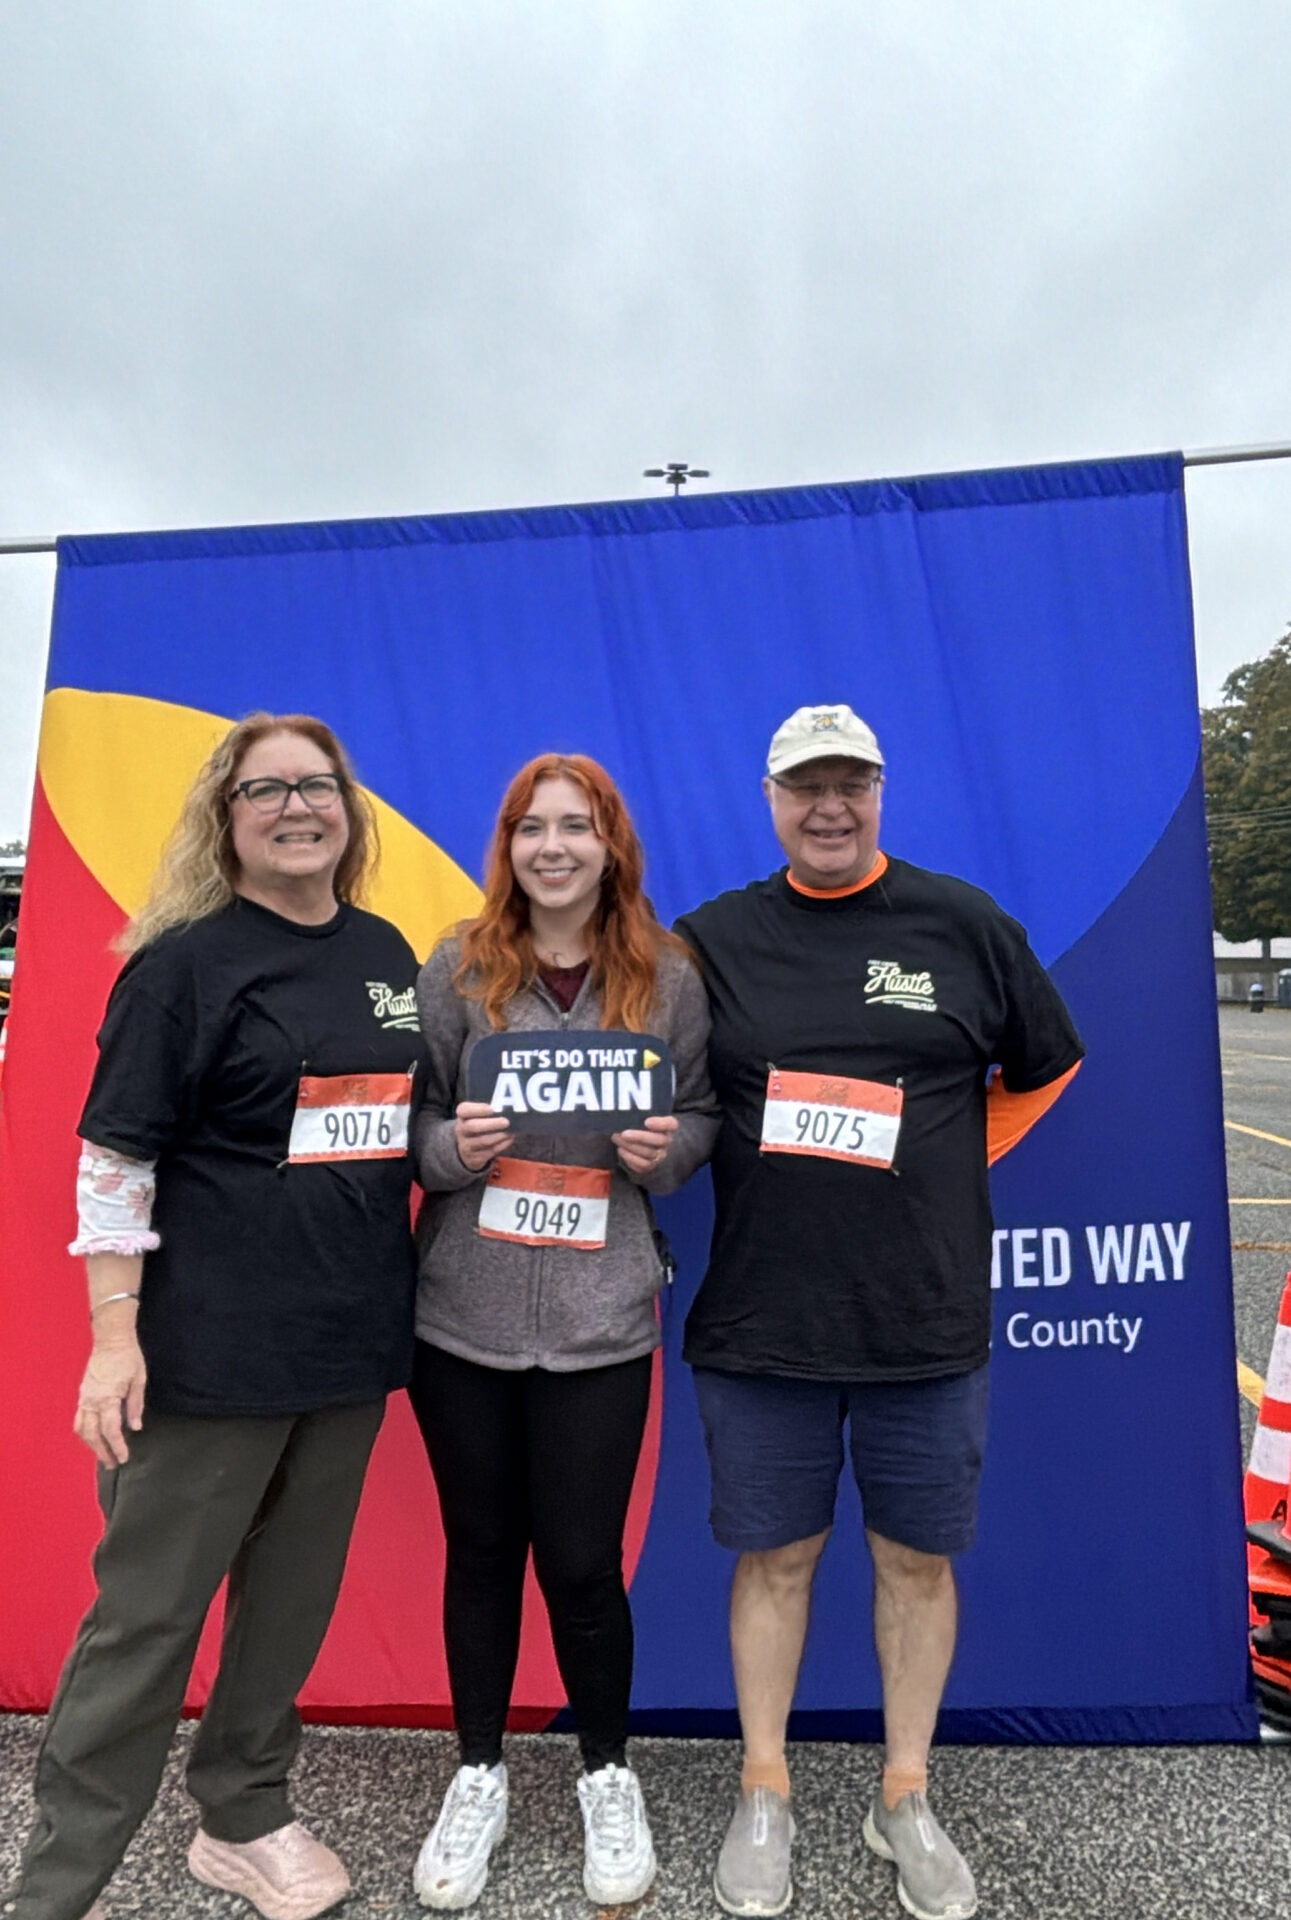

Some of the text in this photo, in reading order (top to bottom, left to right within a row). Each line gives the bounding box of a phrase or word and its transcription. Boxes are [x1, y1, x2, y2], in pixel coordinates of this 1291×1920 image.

[864, 966, 935, 995] Hustle
[368, 986, 419, 1018] Hustl
[501, 1049, 637, 1069] LET'S DO THAT
[490, 1071, 652, 1113] AGAIN
[324, 1111, 391, 1148] 9076
[795, 1108, 867, 1150] 9075
[515, 1197, 581, 1236] 9049
[1085, 1221, 1191, 1285] WAY
[1006, 1312, 1143, 1353] County
